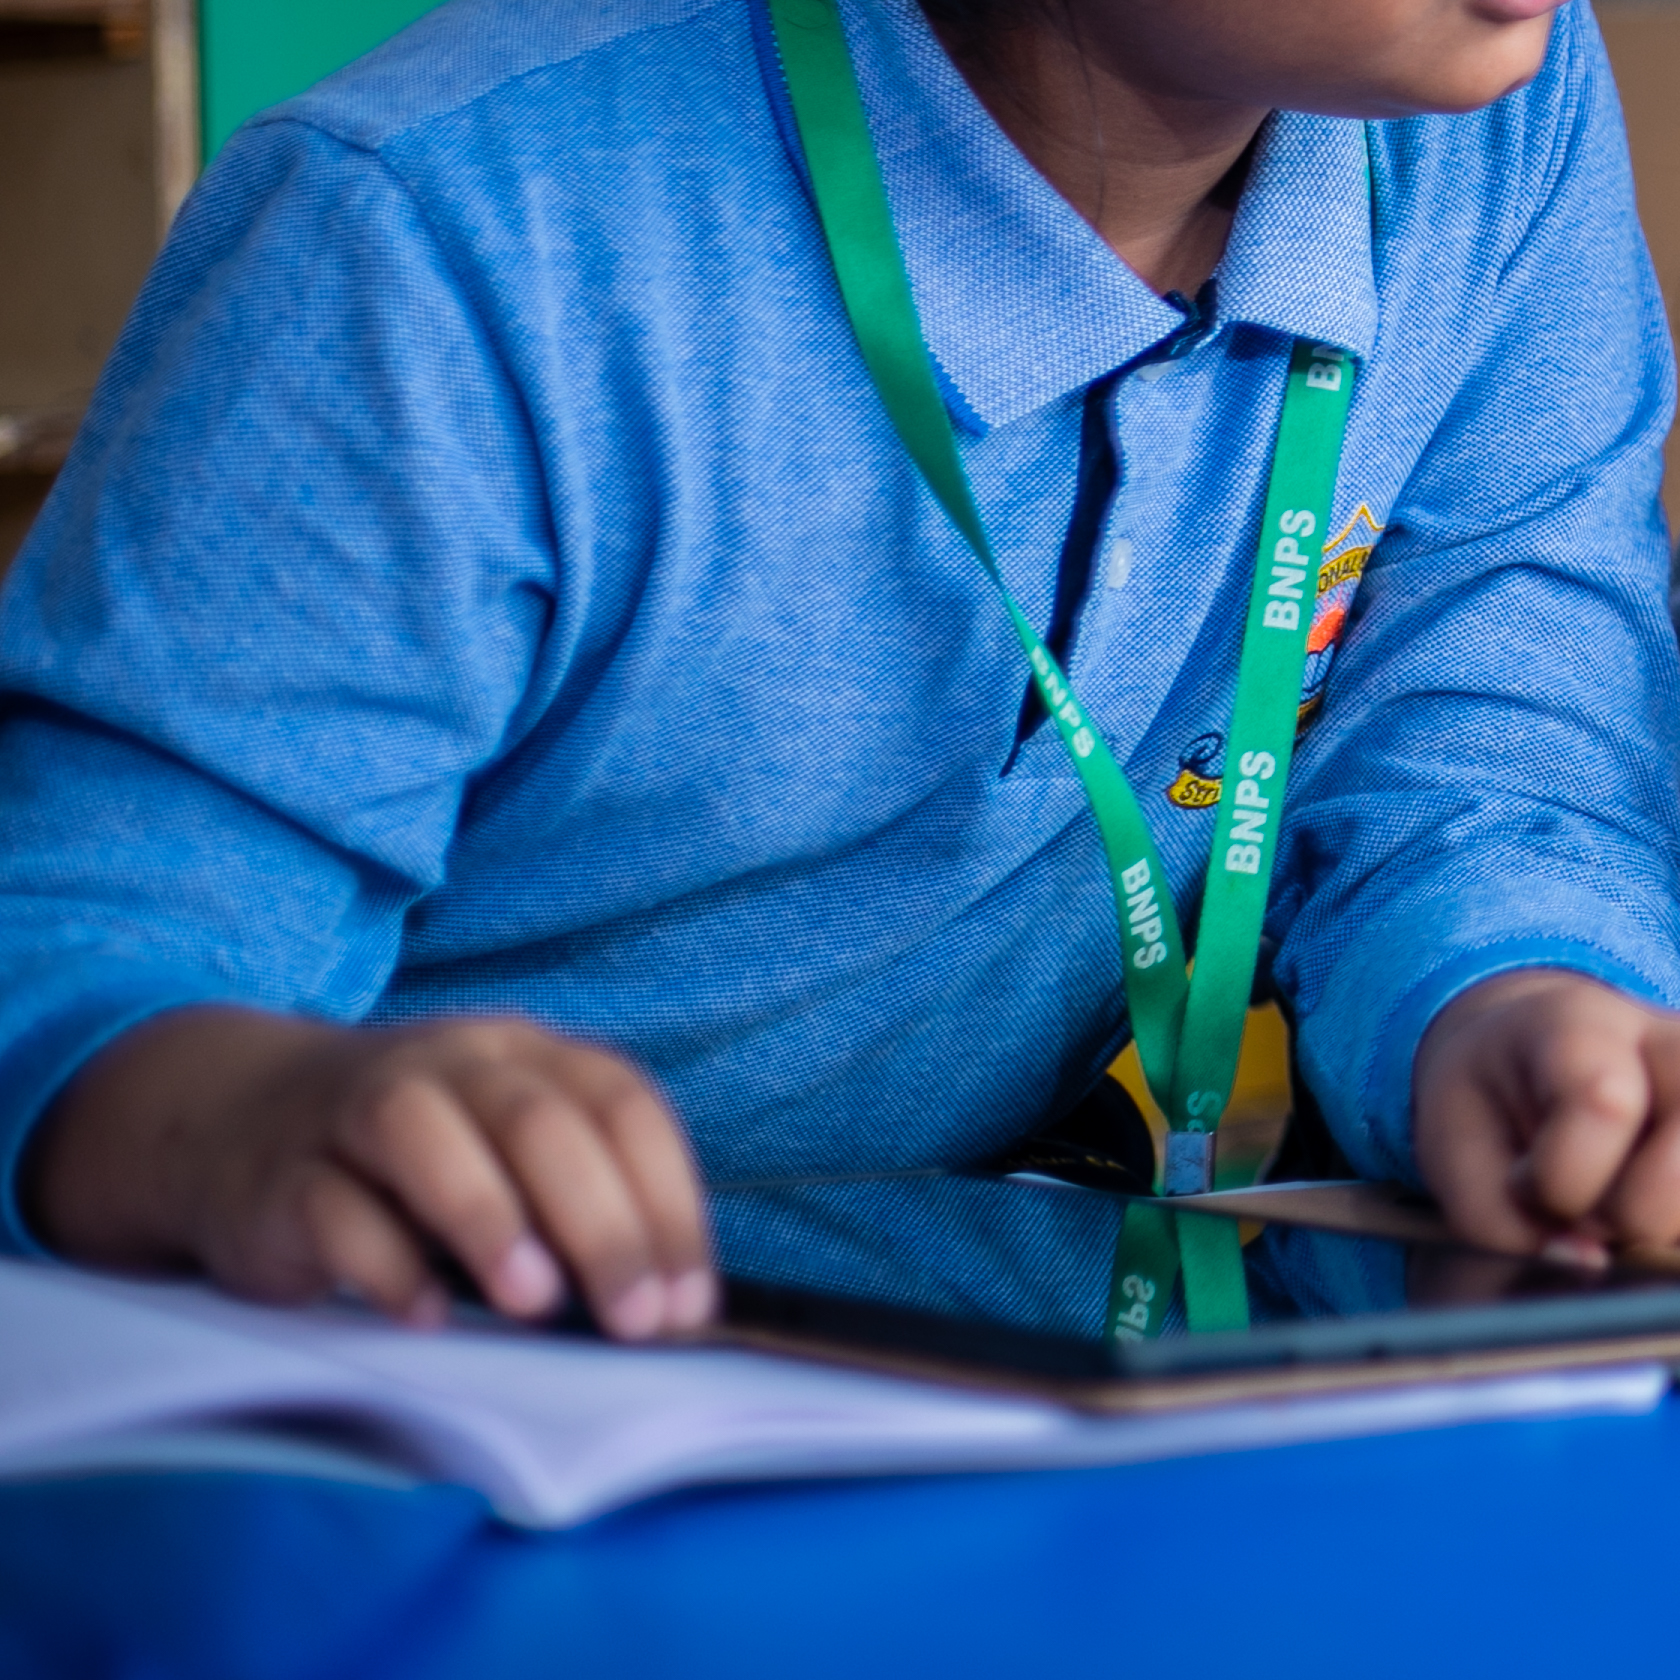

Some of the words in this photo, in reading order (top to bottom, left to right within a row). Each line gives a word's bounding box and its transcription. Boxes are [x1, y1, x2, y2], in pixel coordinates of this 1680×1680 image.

[1263, 509, 1317, 631] BNPS
[1031, 645, 1095, 758] BNPS
[1225, 750, 1276, 874] BNPS
[1121, 857, 1169, 970] BNPS
